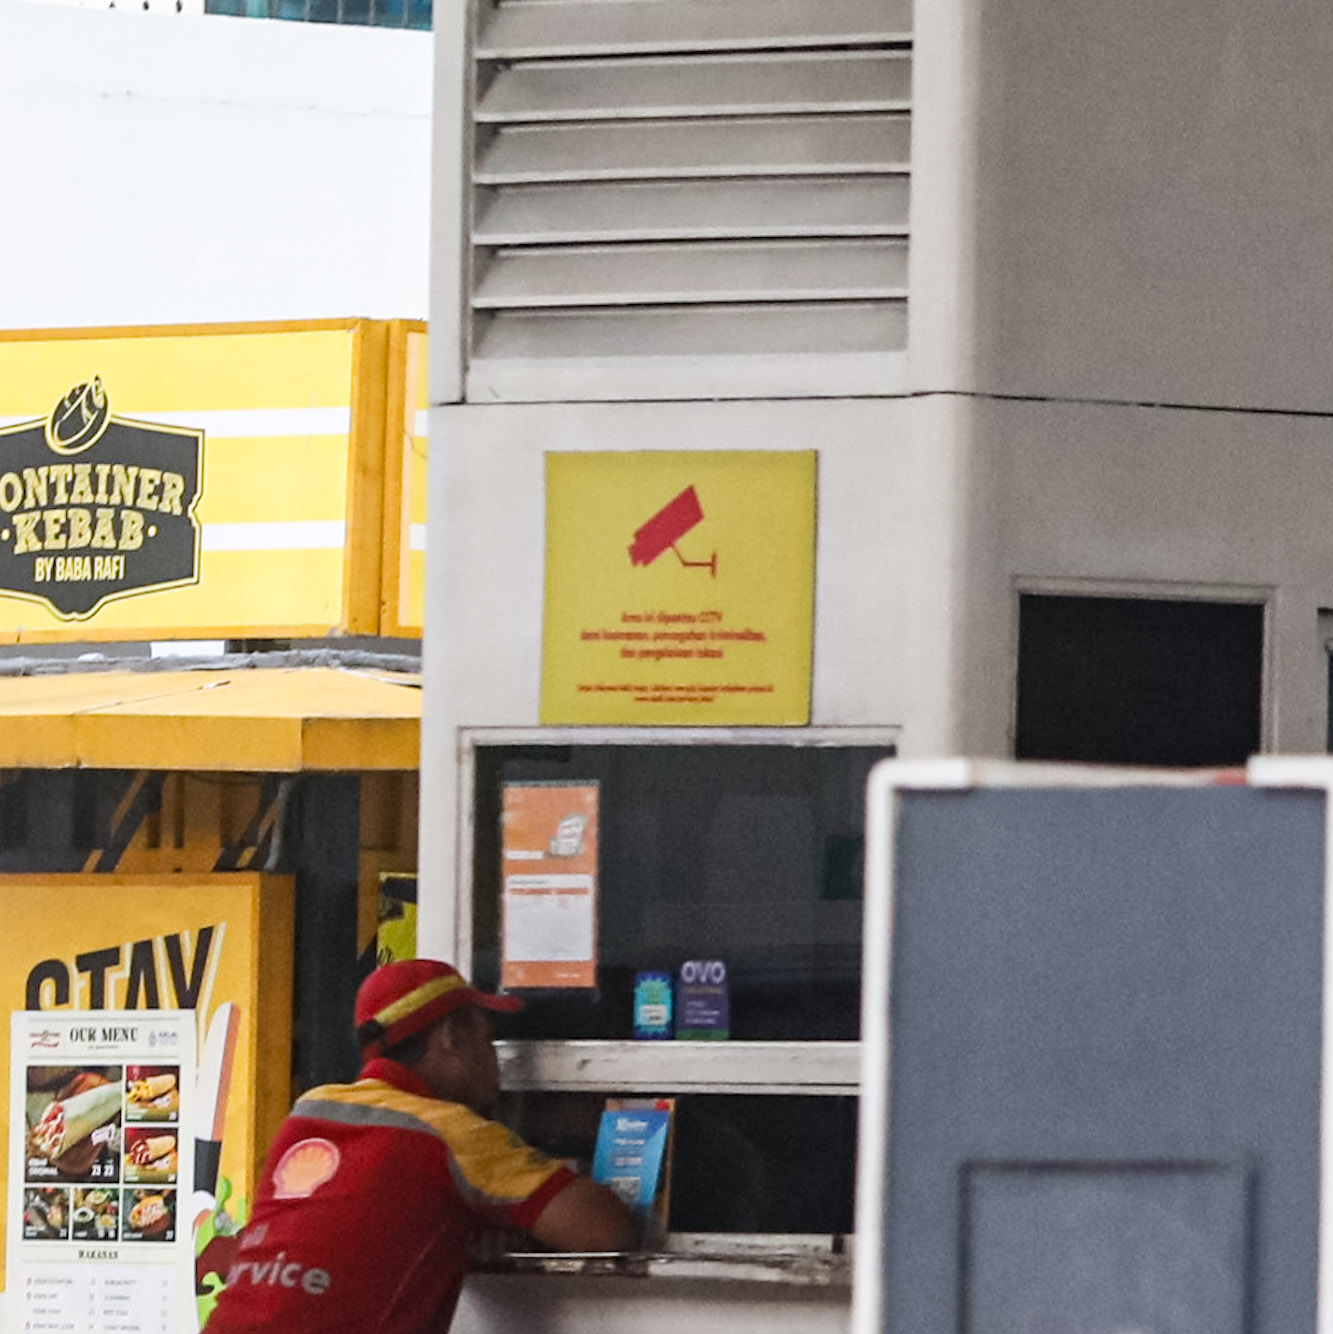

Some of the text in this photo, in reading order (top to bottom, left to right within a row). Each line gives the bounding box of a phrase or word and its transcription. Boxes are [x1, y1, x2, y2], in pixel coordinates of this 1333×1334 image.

[12, 507, 145, 555] KEBAB
[34, 555, 126, 582] BY BABA RAFI
[681, 960, 725, 984] OVO
[69, 1027, 96, 1043] OUR
[101, 1027, 139, 1043] MENU
